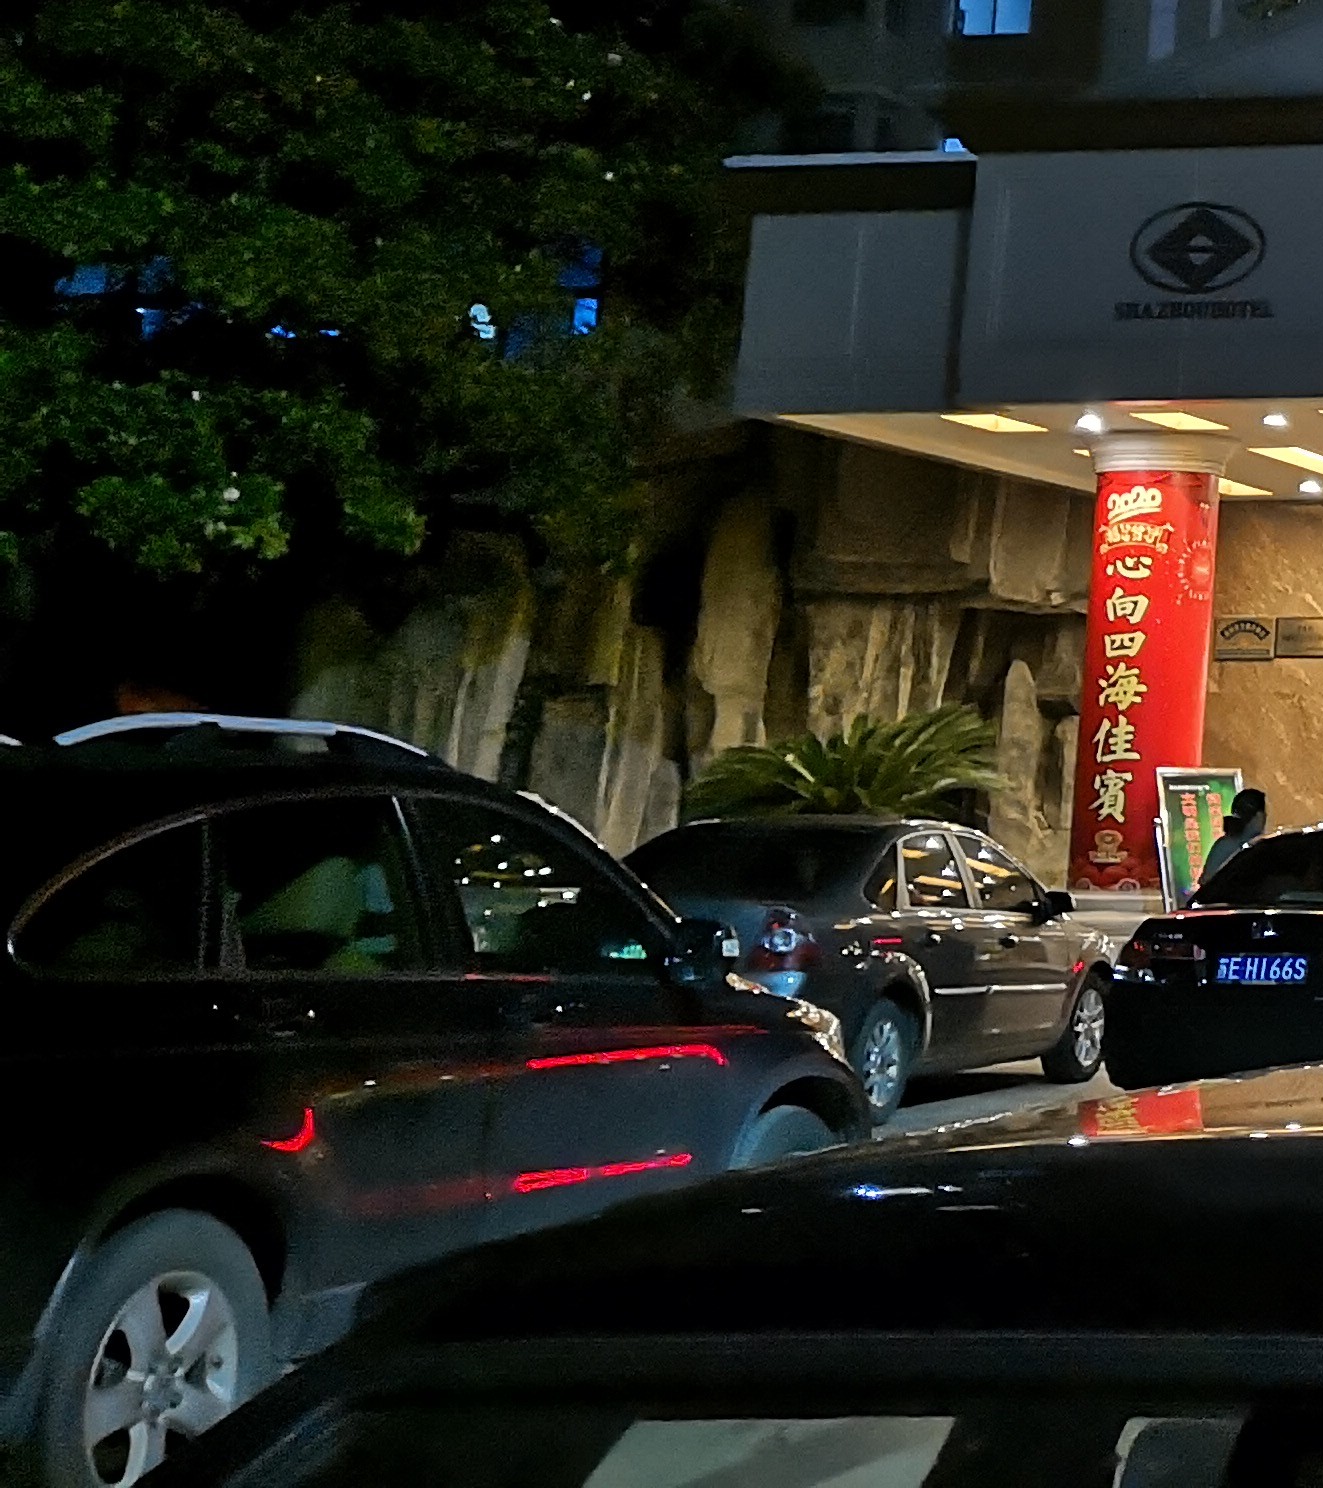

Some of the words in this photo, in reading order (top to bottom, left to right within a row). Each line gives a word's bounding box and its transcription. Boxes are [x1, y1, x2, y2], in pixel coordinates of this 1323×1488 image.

[1107, 485, 1163, 522] 2020
[1088, 556, 1153, 824] 心向四海佳賓
